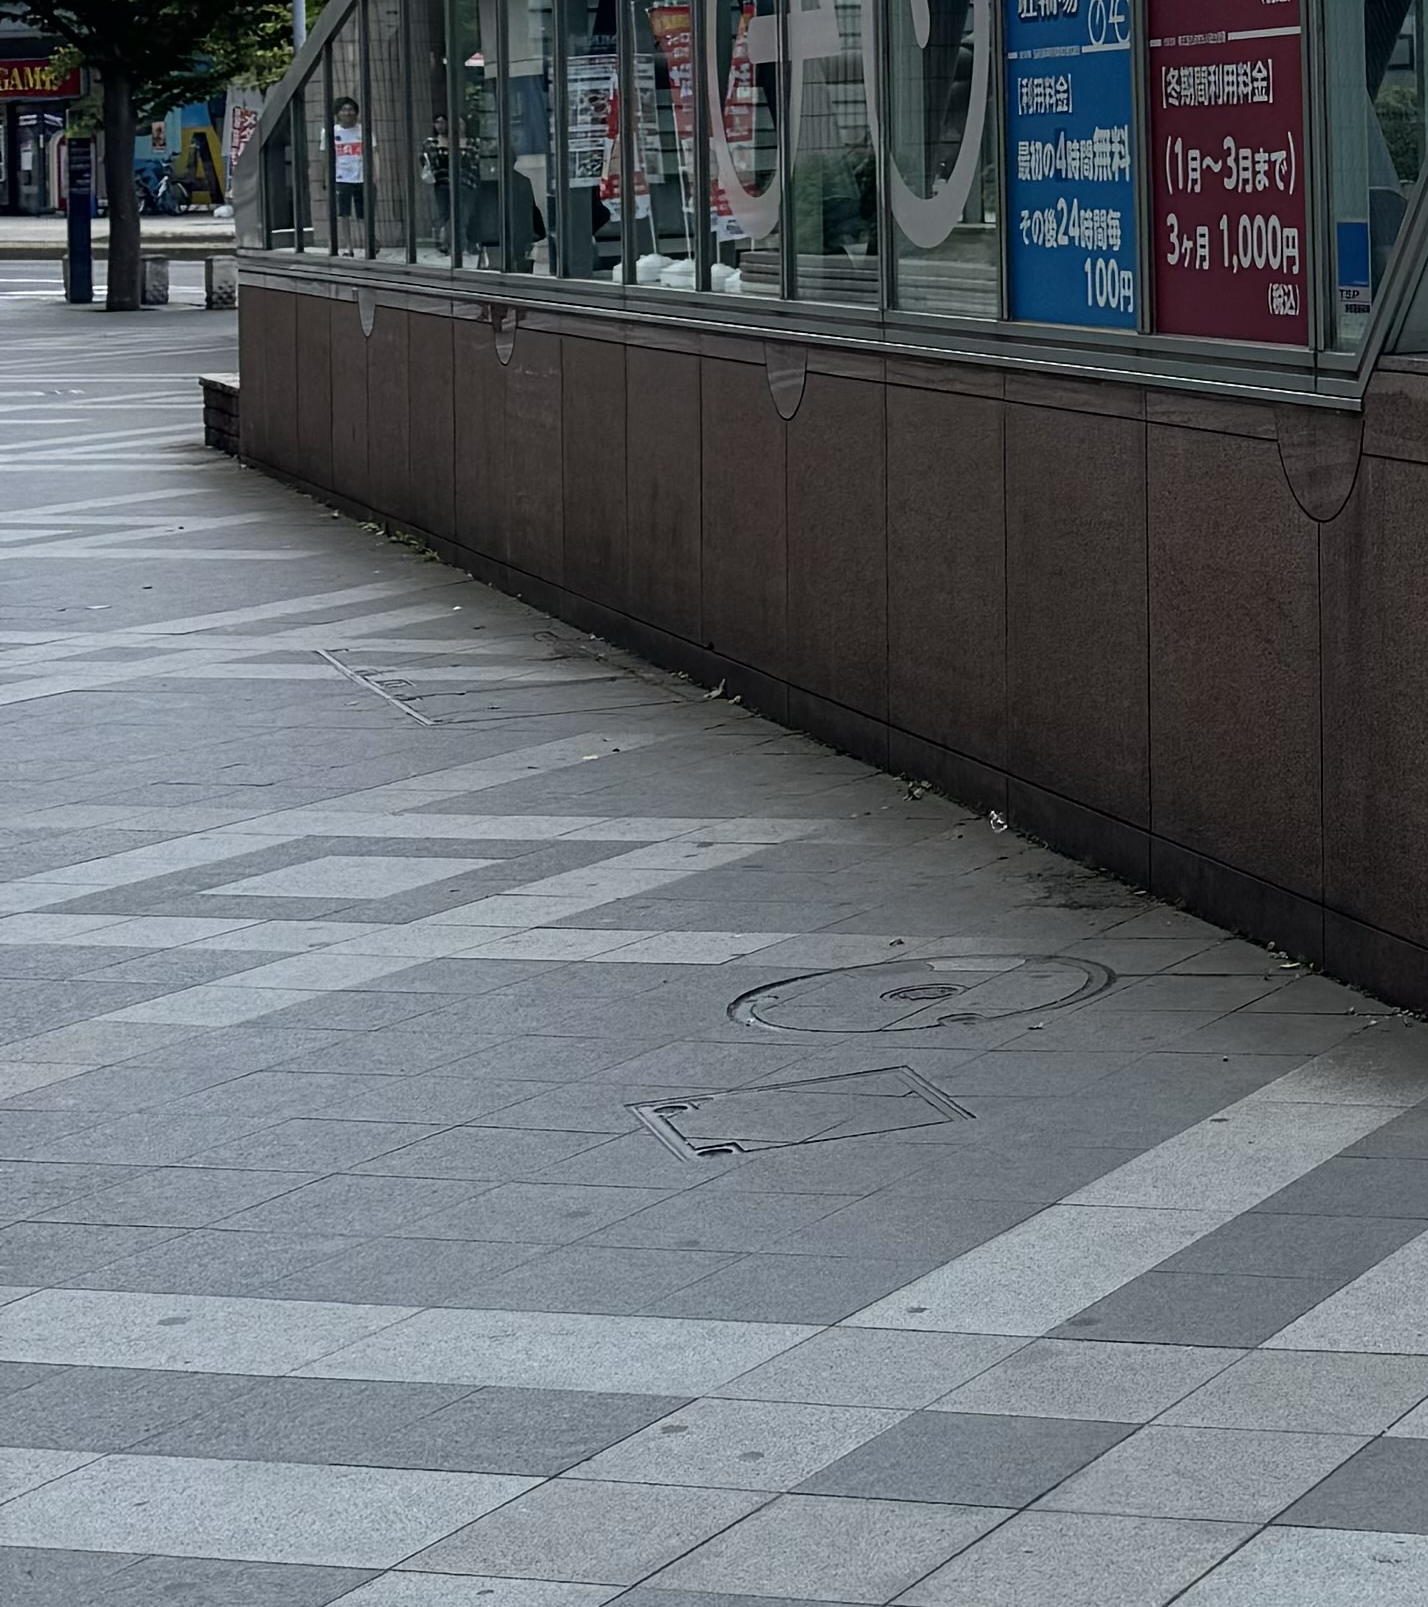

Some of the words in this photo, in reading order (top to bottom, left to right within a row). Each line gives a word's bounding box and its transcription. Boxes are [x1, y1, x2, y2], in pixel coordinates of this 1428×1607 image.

[1017, 124, 1131, 182] 最初の4時間無料
[1019, 198, 1122, 252] その後24時間毎
[1220, 214, 1299, 274] 1,000円
[1084, 257, 1134, 314] 100円
